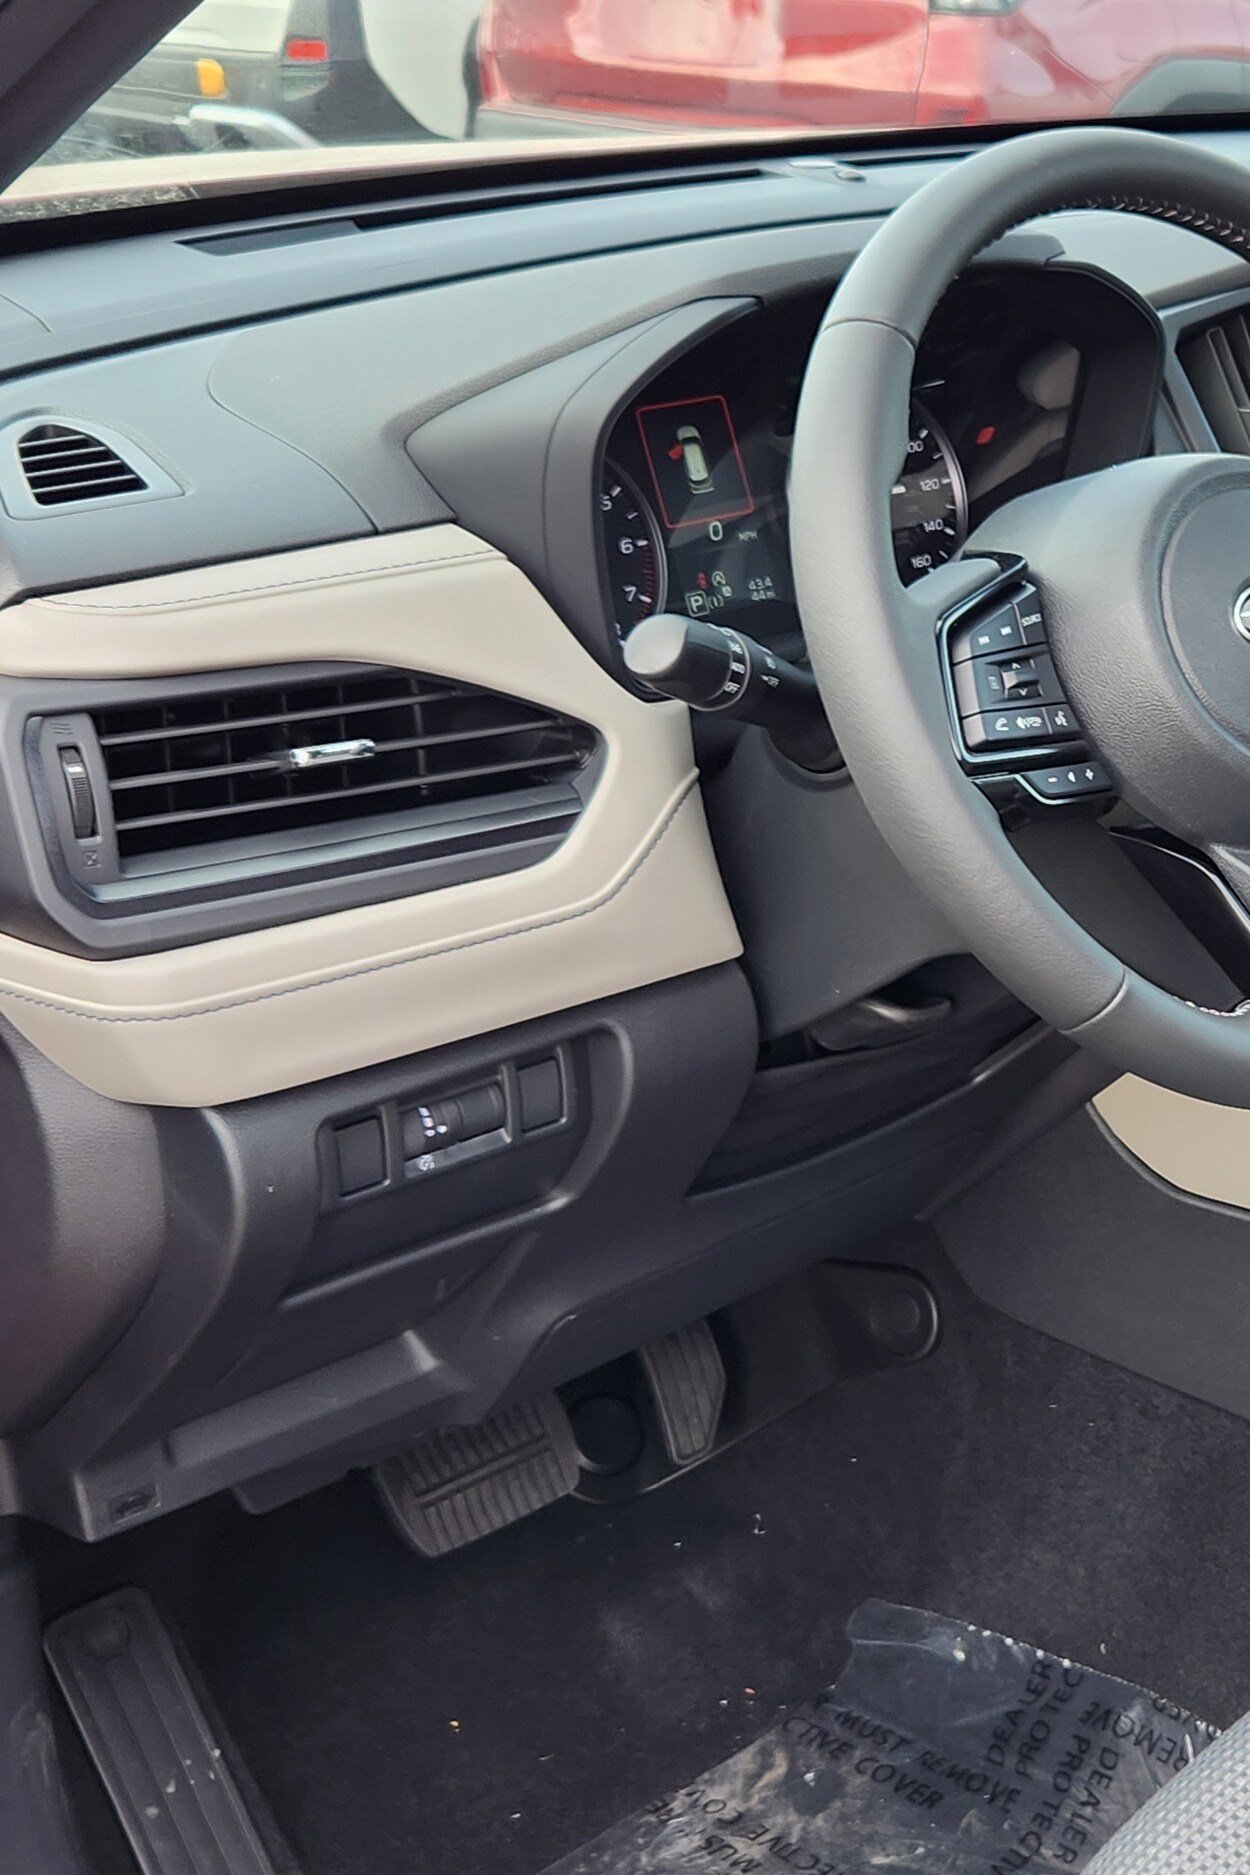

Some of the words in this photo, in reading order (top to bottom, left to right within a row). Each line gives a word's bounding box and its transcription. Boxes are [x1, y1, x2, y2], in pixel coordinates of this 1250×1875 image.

[920, 479, 939, 491] 120
[601, 493, 612, 511] 5
[709, 520, 723, 541] 0
[923, 519, 944, 533] 140
[738, 529, 757, 542] MPH
[620, 538, 634, 554] 6
[910, 554, 932, 569] 160
[622, 585, 638, 602] 7
[690, 595, 703, 612] P
[1021, 613, 1042, 627] SOURCE
[986, 1659, 1053, 1767] DEALER
[1014, 1667, 1084, 1781] PROTEC
[1079, 1700, 1189, 1772] REMOVE
[782, 1715, 854, 1760] CTIVE
[855, 1757, 945, 1810] COVER
[834, 1709, 914, 1752] MUST
[913, 1750, 1022, 1814] REMOVE
[1053, 1747, 1120, 1865] DEALER
